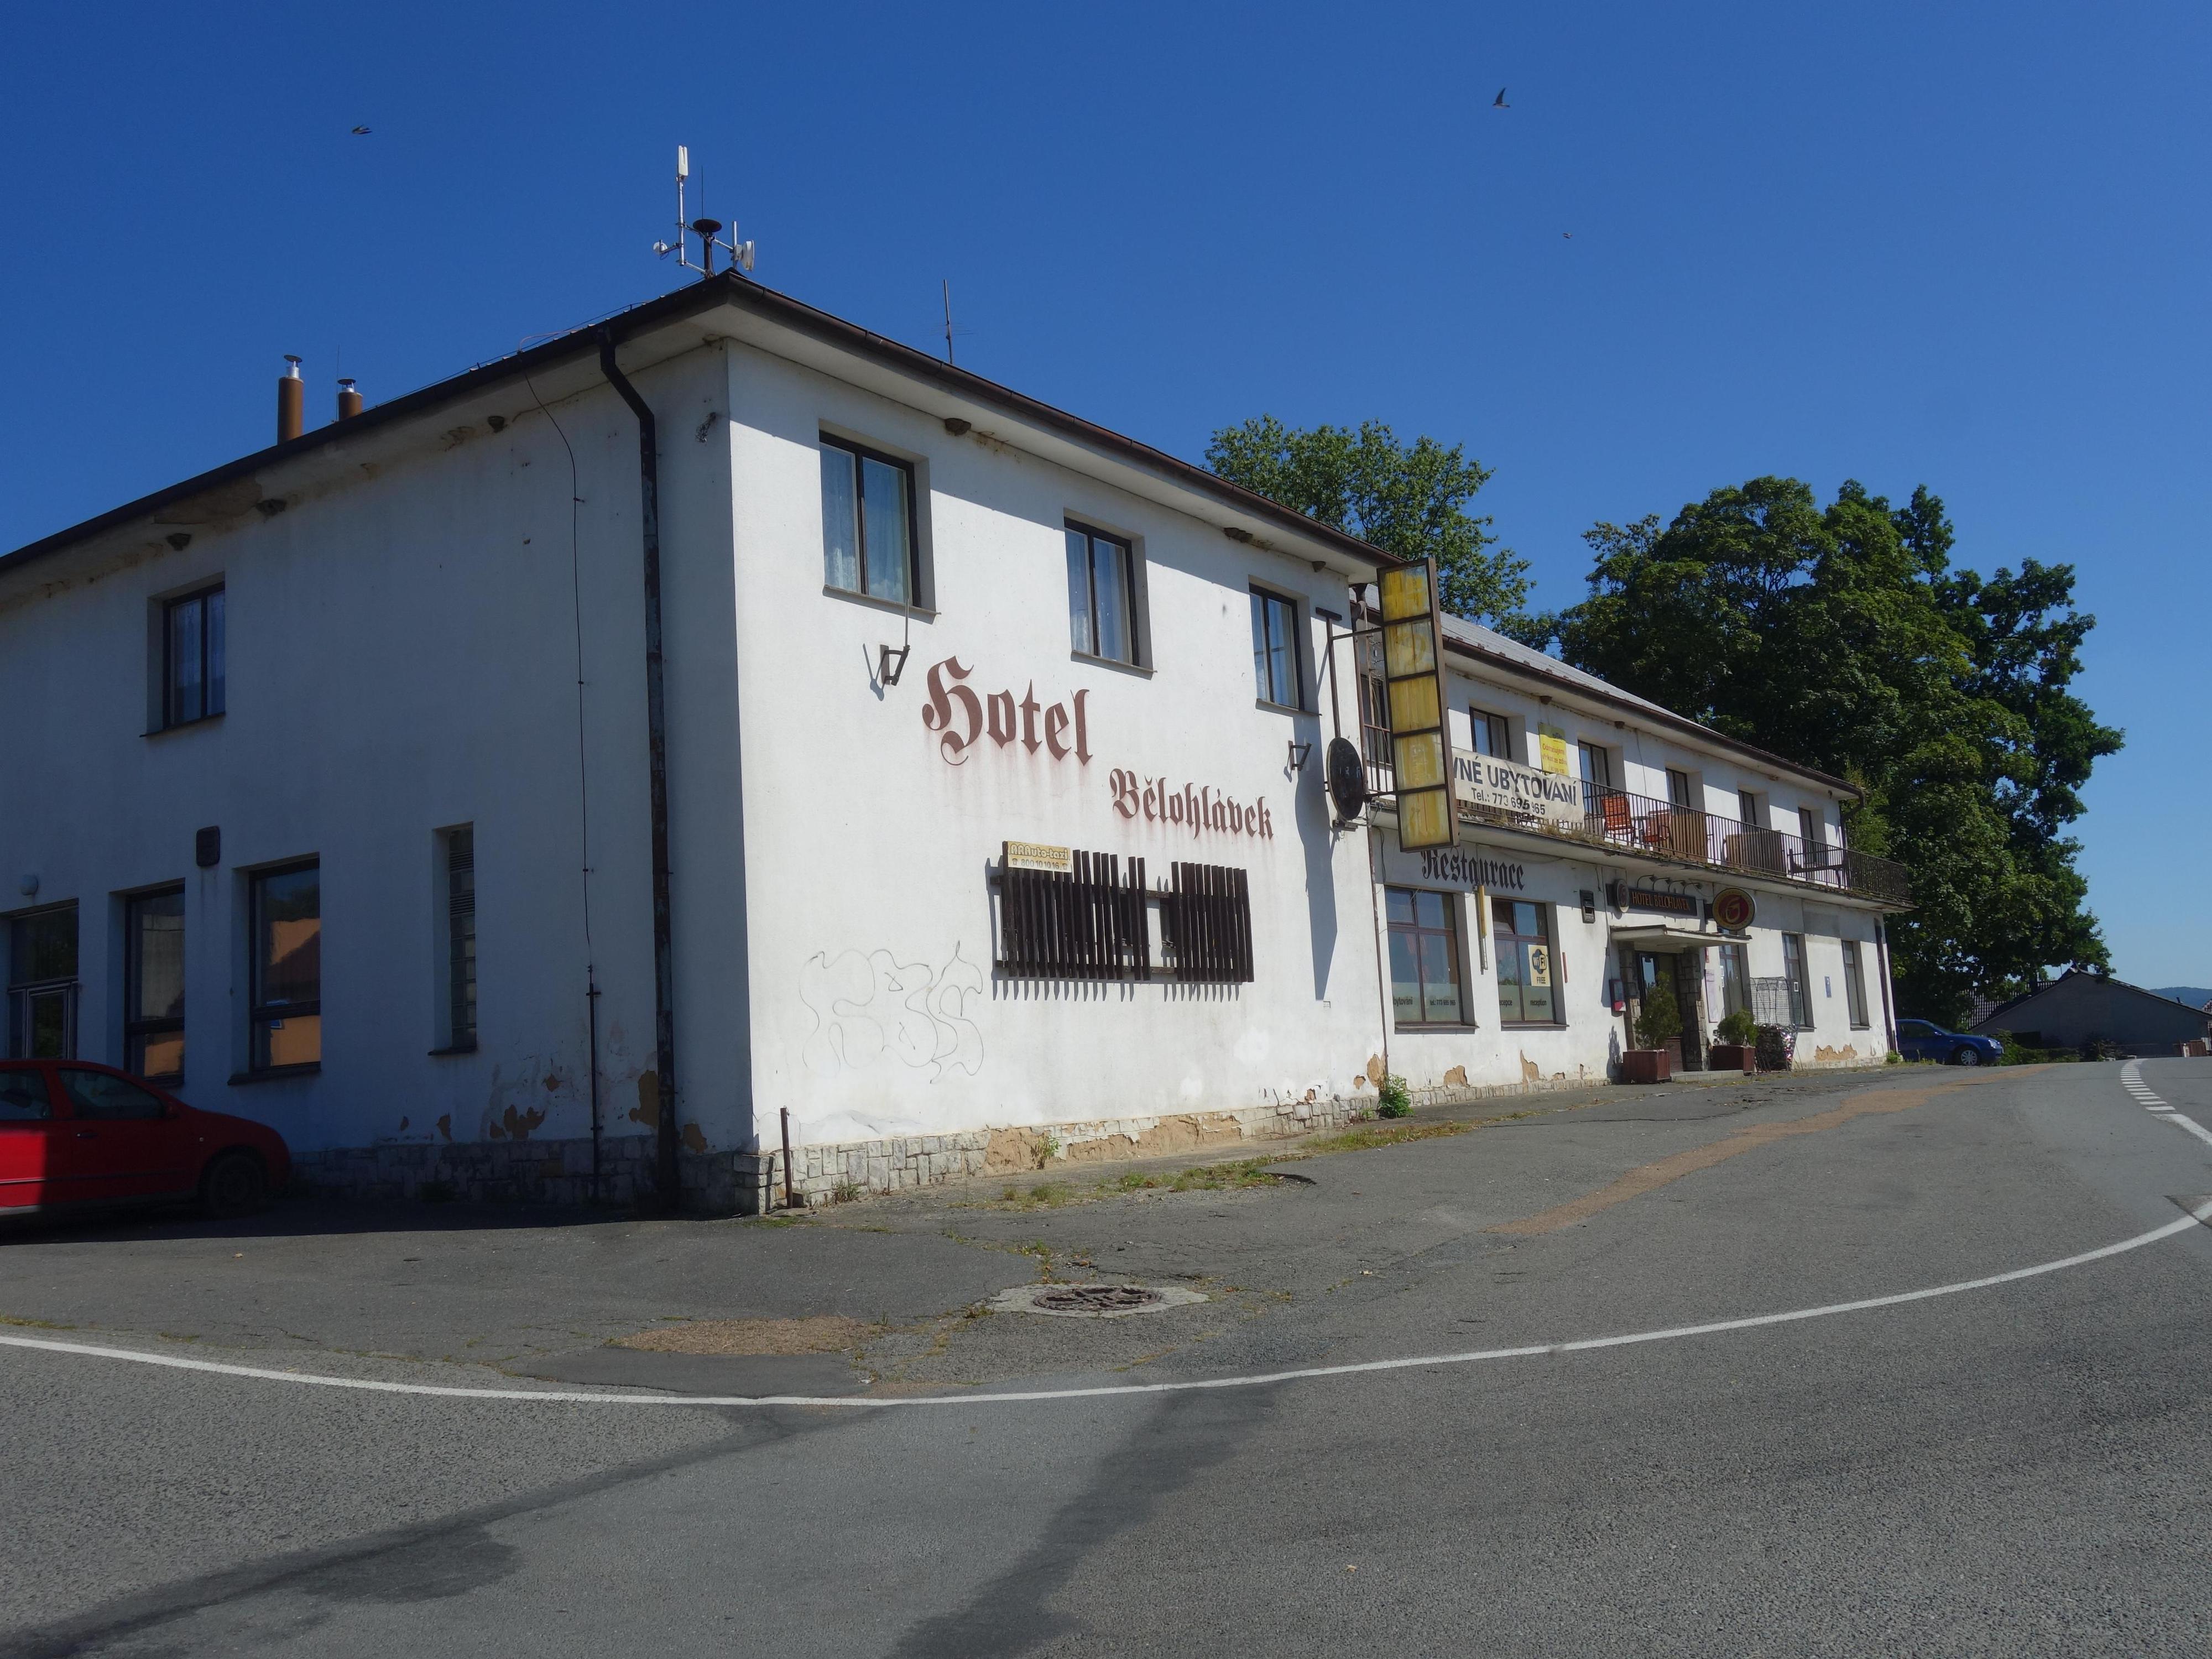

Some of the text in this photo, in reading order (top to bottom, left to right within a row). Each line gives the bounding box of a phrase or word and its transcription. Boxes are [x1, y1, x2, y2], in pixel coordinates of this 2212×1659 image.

[922, 655, 1093, 766] Hotel
[1109, 768, 1274, 841] Bělohlávek
[1471, 787, 1546, 815] Tel.: 773 695 965
[1421, 847, 1525, 891] Restaurace
[1632, 891, 1653, 906] HOTEL
